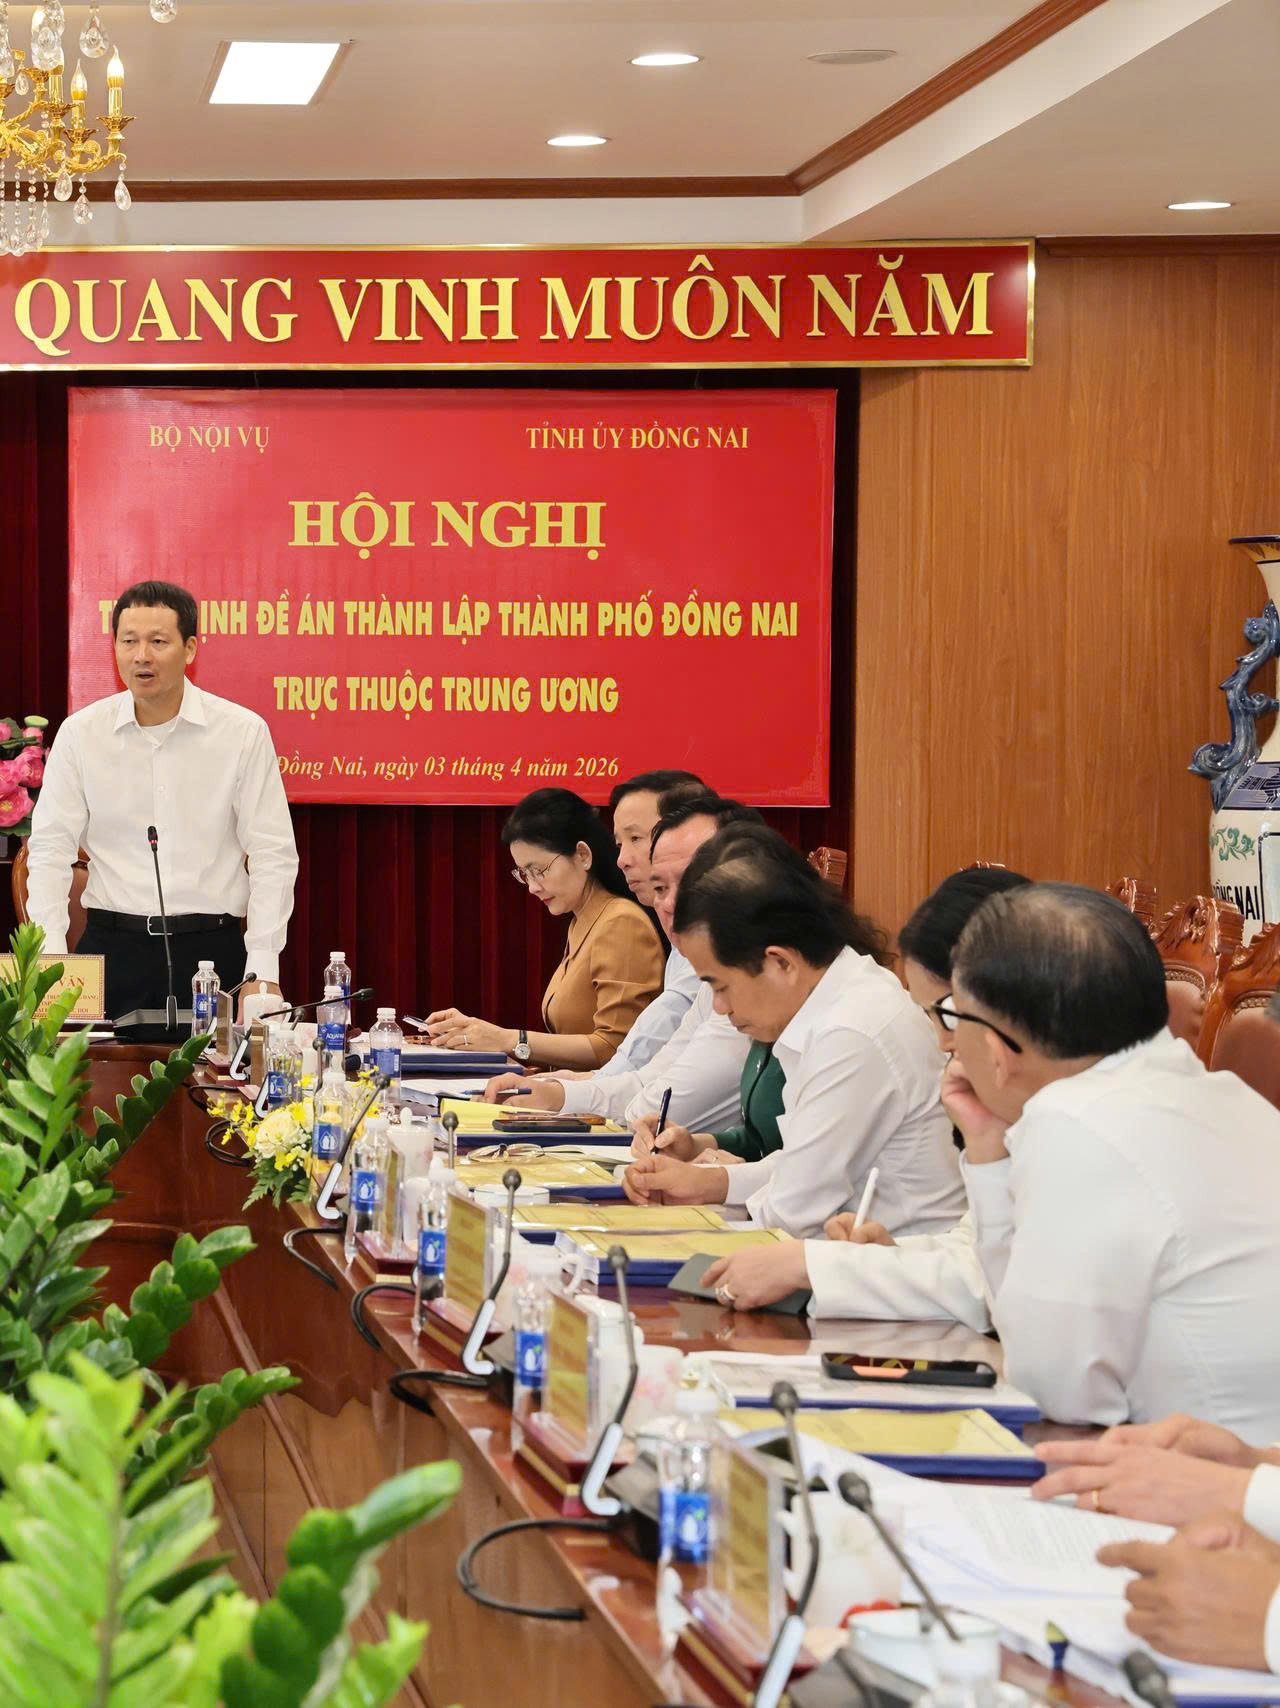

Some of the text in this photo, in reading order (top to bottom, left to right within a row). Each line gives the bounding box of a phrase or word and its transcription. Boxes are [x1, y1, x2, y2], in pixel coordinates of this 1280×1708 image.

[13, 277, 298, 356] QUANG
[319, 277, 519, 342] VINH
[540, 254, 785, 340] MUÔN
[807, 253, 994, 337] NĂM
[149, 422, 270, 454] BỘ NỘI VỤ
[526, 420, 748, 449] TỈNH ỦY ĐỒNG NAI
[288, 491, 607, 561] HỘI NGHỊ
[199, 588, 799, 646] ỊNH ĐỀ ÁN THÀNH LẬP THÀNH PHỐ ĐỒNG NAI
[273, 668, 619, 721] TRỰC THUỘC TRUNG ƯƠNG
[276, 751, 619, 781] Đồng Nai, ngày 03 tháng 4 năm 2026
